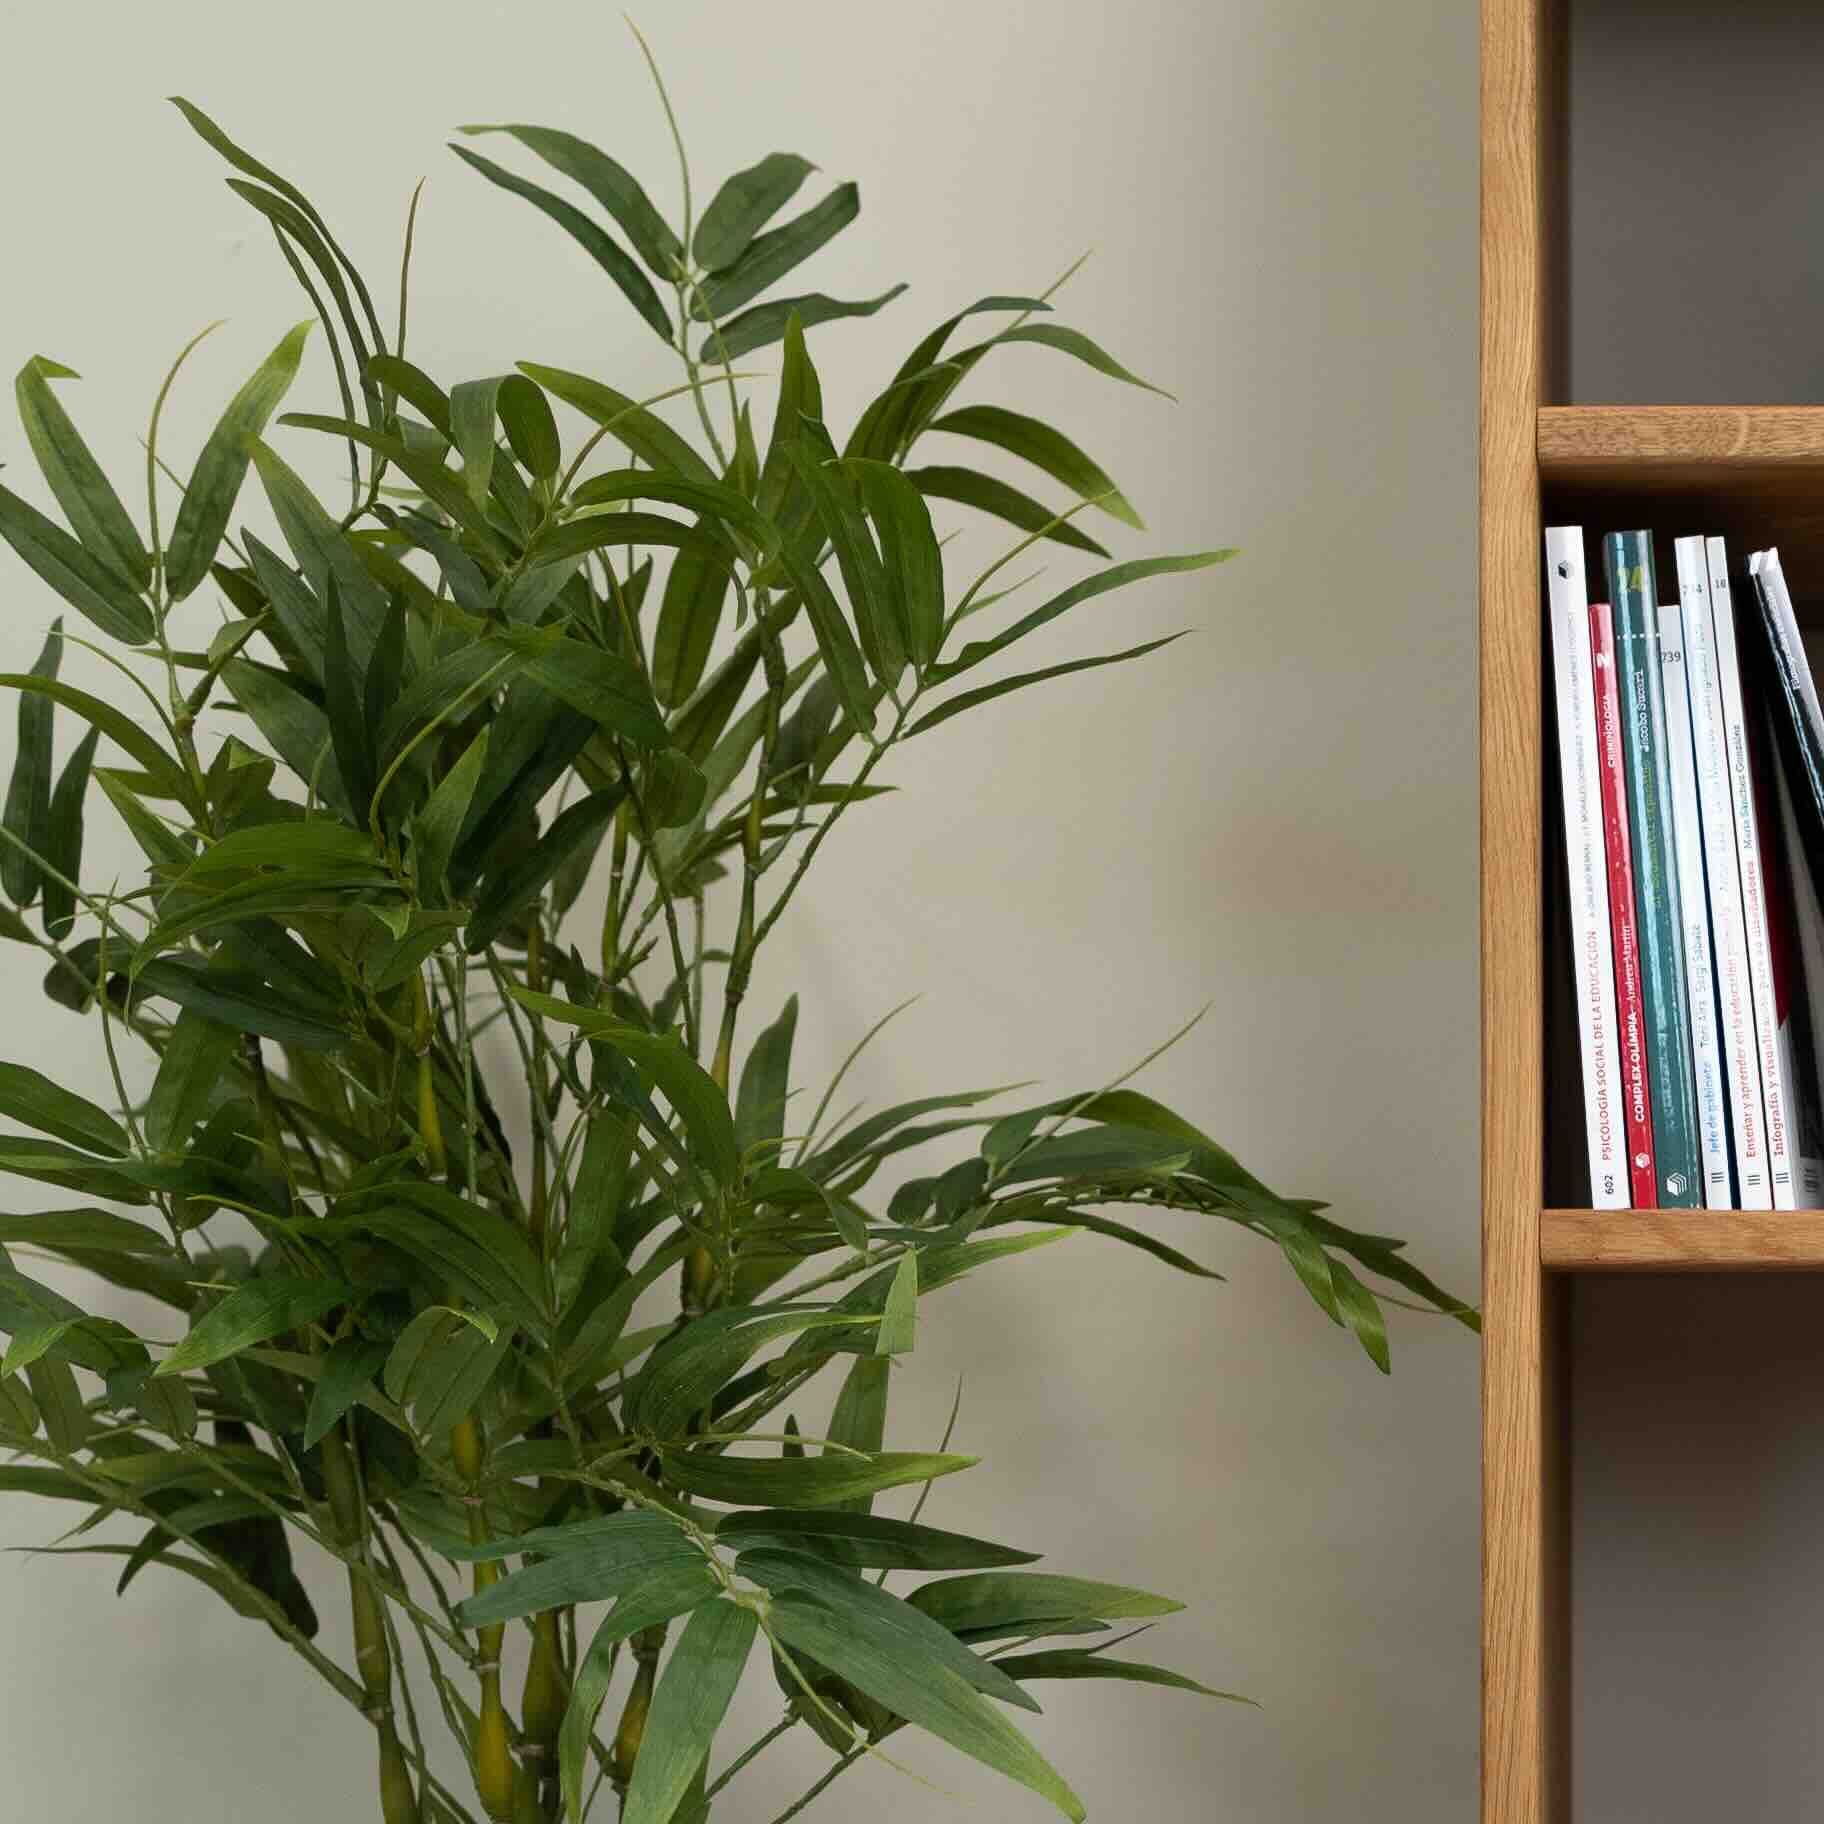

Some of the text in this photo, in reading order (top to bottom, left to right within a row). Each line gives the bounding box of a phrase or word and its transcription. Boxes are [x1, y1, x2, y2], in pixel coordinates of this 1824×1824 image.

[1637, 712, 1649, 751] Jacobo
[1585, 930, 1601, 1002] EDUCACIÓN
[1592, 1005, 1602, 1020] LA
[1593, 1023, 1604, 1040] DE
[1595, 1042, 1607, 1085] SOCIAL
[1631, 1064, 1645, 1122] COMPLEX
[1597, 1088, 1612, 1161] PSICOLOGÍA
[1604, 1174, 1615, 1194] 602
